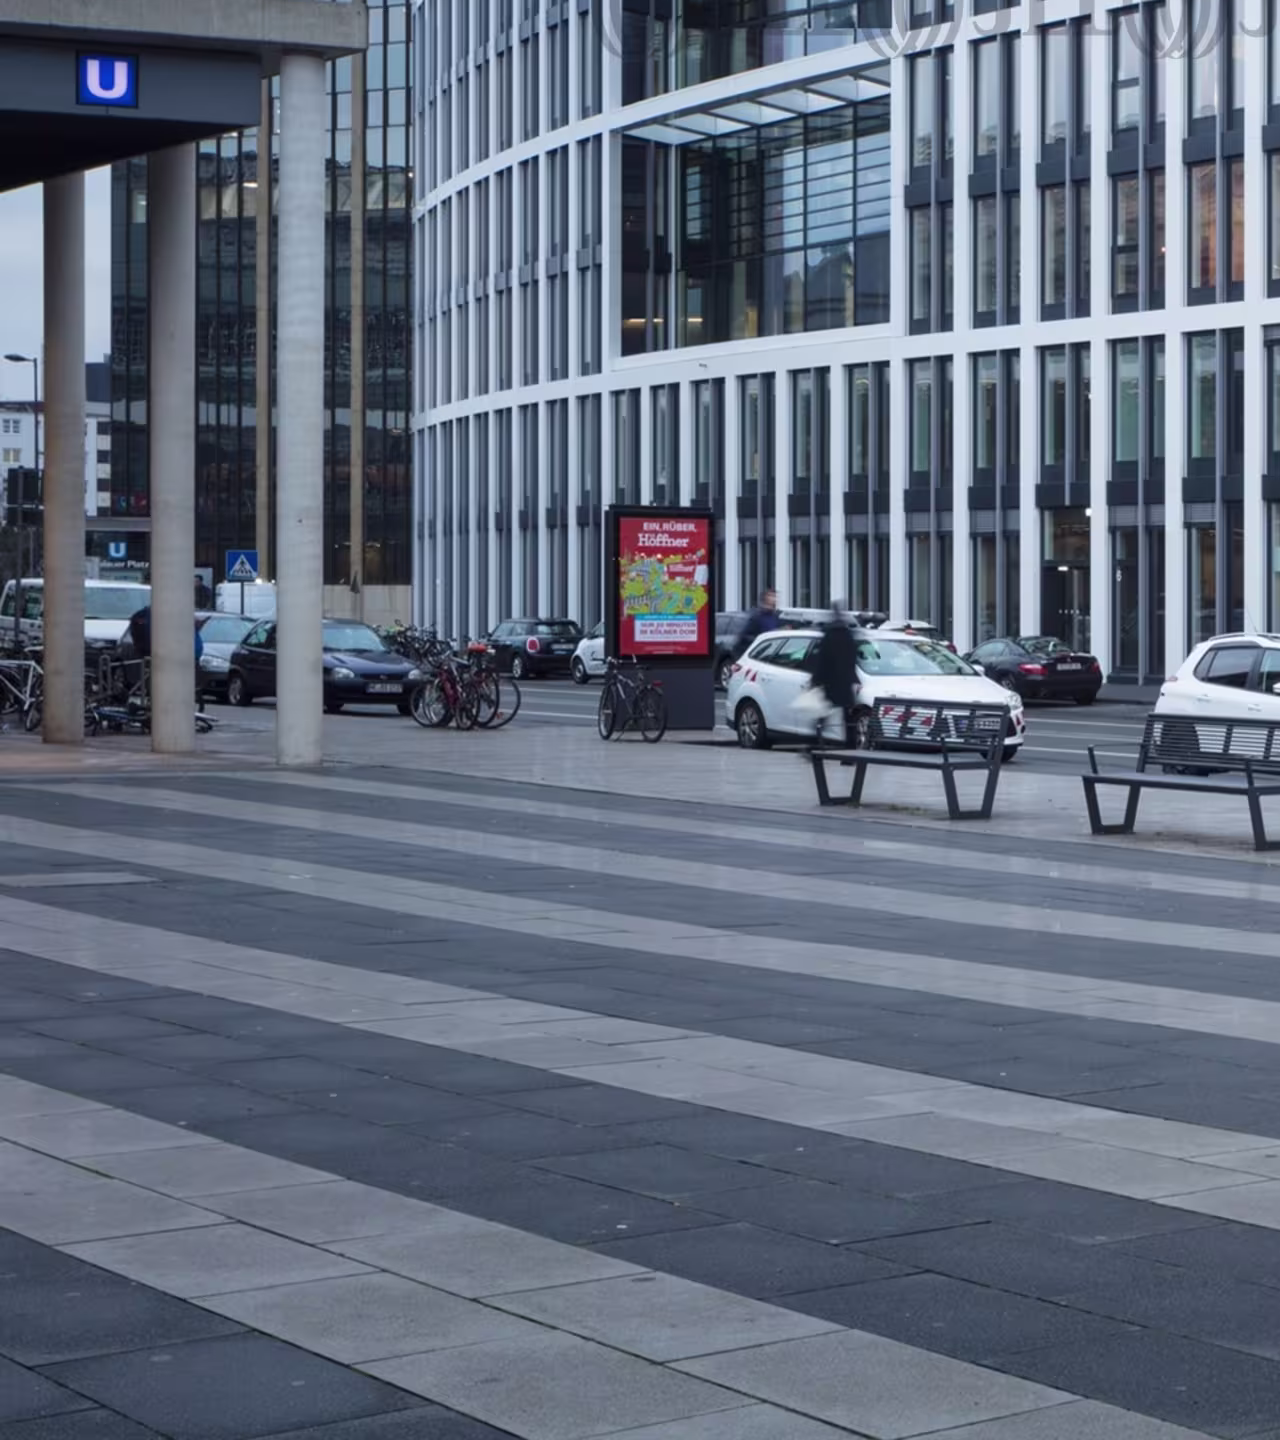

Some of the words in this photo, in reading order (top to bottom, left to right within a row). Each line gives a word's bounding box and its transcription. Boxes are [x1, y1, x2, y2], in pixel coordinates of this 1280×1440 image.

[86, 58, 129, 99] U
[637, 533, 689, 547] Höffner
[109, 542, 126, 557] U
[127, 559, 150, 568] Platz
